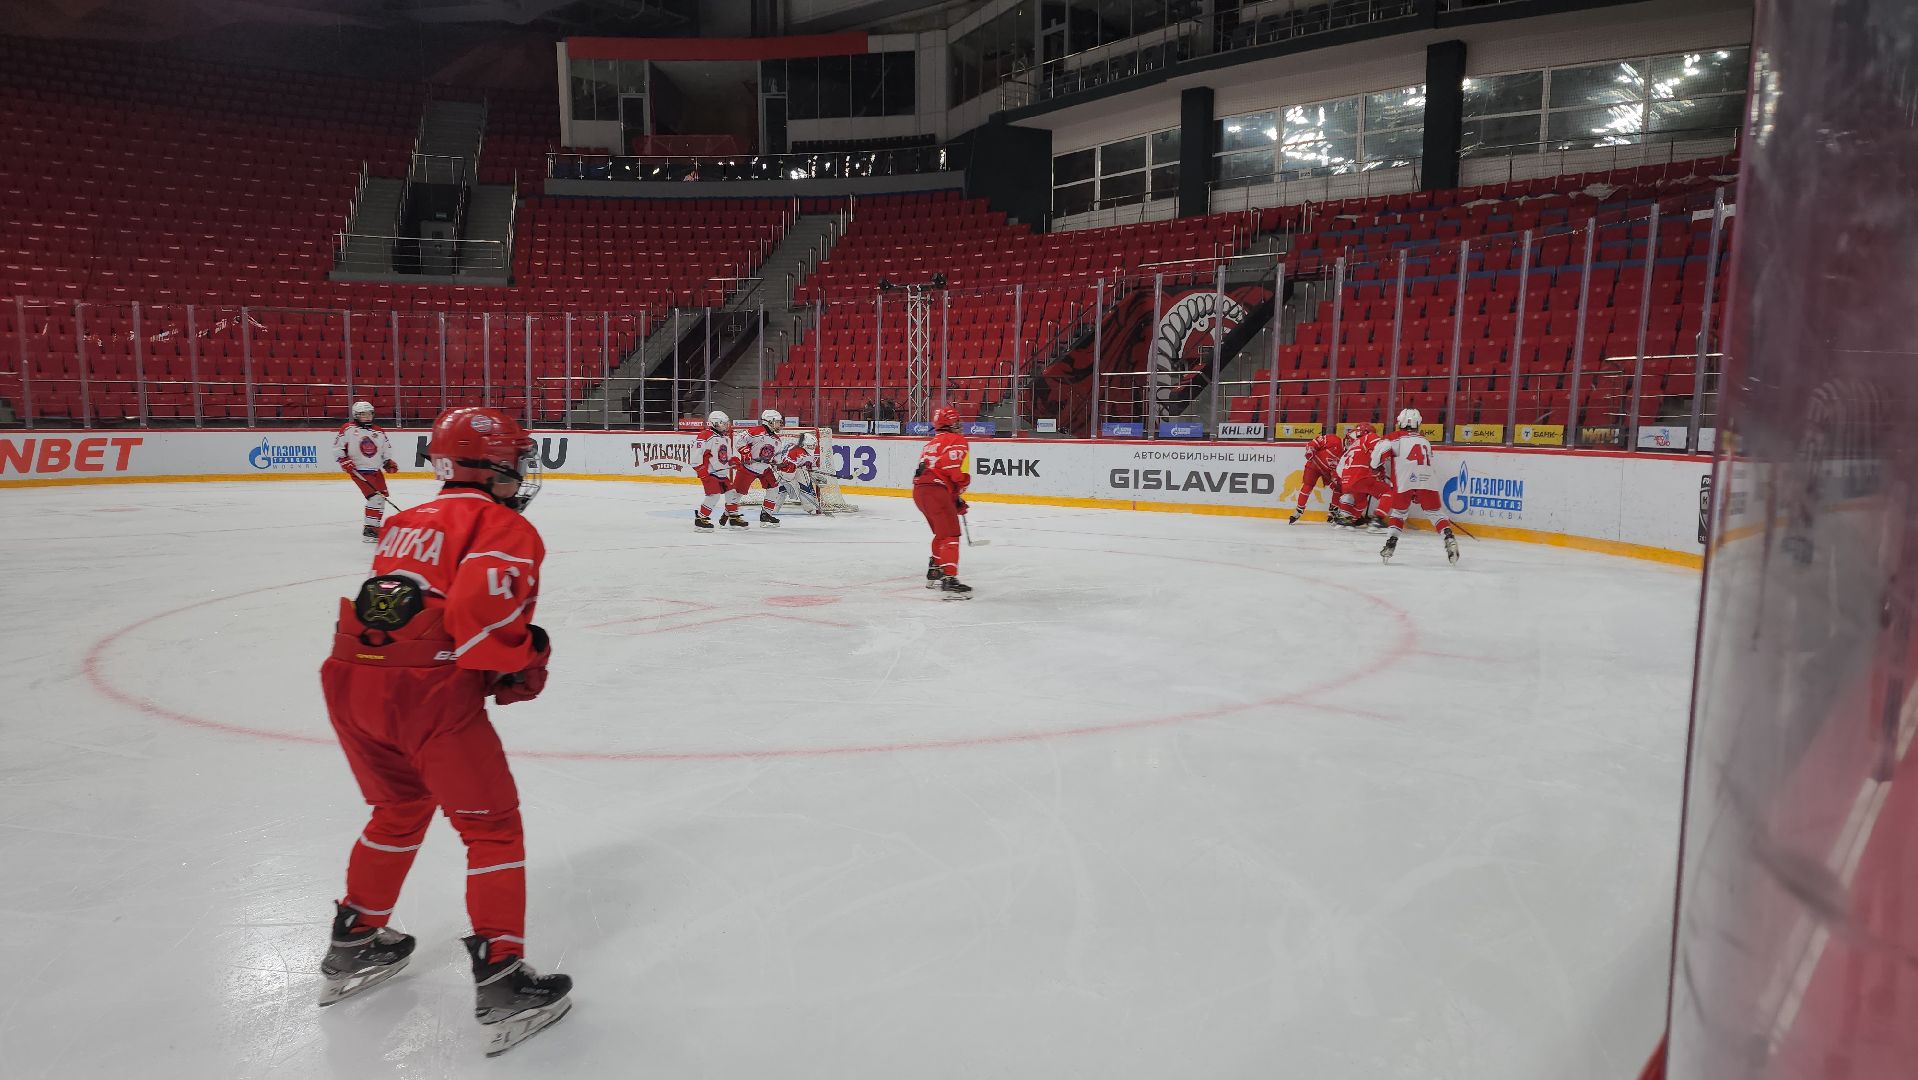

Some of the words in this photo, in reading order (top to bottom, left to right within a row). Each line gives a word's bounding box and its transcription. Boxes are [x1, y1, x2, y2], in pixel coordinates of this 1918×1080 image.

[1221, 426, 1262, 436] KHL.RU
[271, 445, 317, 456] ГАЗПРОМ
[1134, 451, 1234, 461] АВТОМОБИЛЬНЫЕ
[1238, 453, 1275, 462] ШИНЫ
[976, 457, 1041, 477] БАНК
[1110, 468, 1275, 494] GISLAVED
[1470, 477, 1524, 498] ГАЗПРОМ
[1470, 497, 1522, 510] ТРАНСГАЗ
